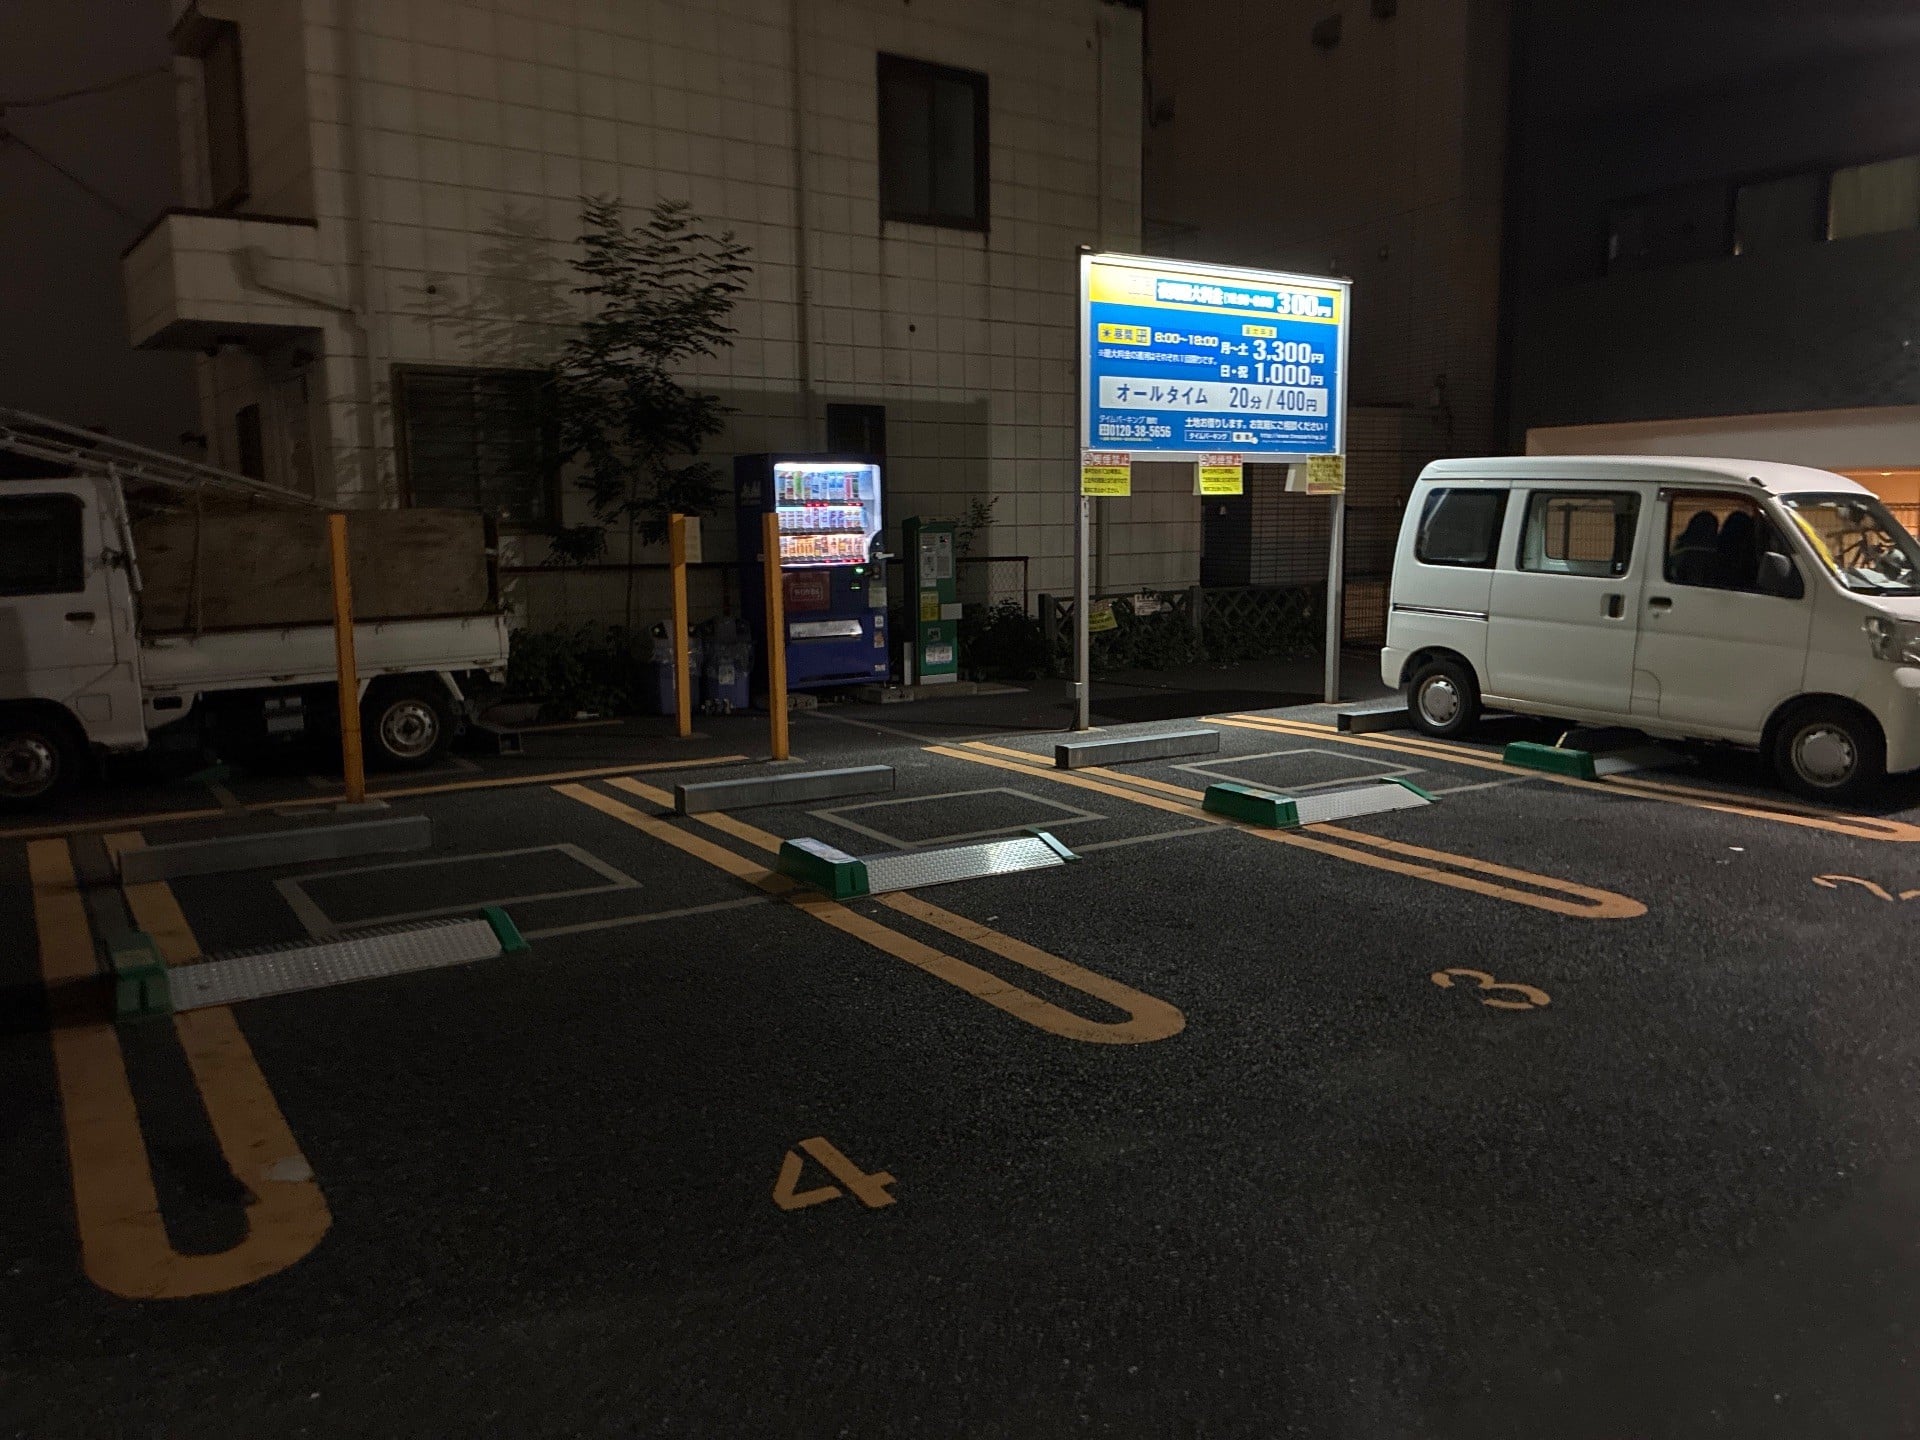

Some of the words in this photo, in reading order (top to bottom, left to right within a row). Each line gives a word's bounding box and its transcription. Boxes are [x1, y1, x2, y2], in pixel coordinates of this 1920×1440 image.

[1252, 339, 1325, 364] 3,300円
[1254, 362, 1324, 386] 1,000円
[1116, 383, 1209, 405] オールタイム
[1109, 424, 1172, 438] 0120-38-5656
[1431, 968, 1552, 1010] 3
[772, 1135, 898, 1212] 4
